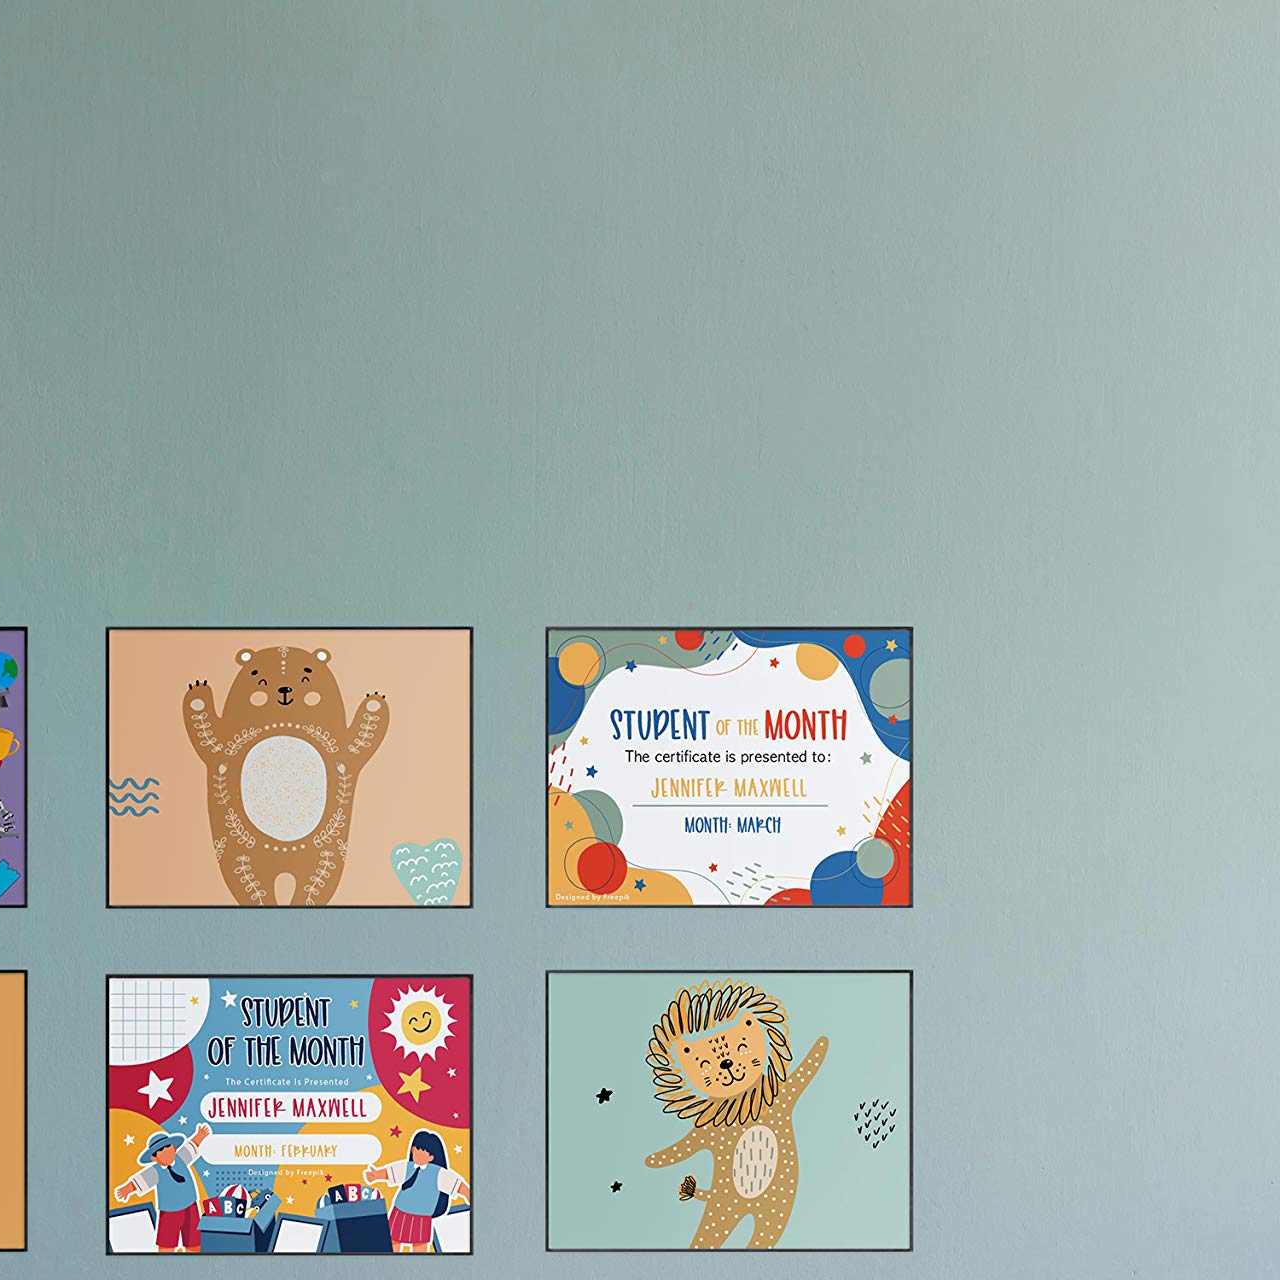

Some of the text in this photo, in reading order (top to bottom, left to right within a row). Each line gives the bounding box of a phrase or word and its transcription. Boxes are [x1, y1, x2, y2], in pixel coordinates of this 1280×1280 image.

[610, 708, 847, 741] STUDENT OF THE MONTH
[625, 750, 832, 765] The certificate is presented to:
[651, 777, 807, 798] JENNIFER MAXWELL
[685, 816, 781, 833] MONTH: MARCH
[555, 893, 630, 902] Designed by Freepik
[241, 996, 331, 1028] STUDENT
[208, 1035, 365, 1067] OF THE MONTH
[225, 1077, 349, 1086] The Certificate Is Presented
[208, 1097, 367, 1118] JENNIFER MAXWELL
[281, 1144, 337, 1158] FEBRUARY
[248, 1169, 324, 1177] Designed by Freepik
[335, 1186, 369, 1202] A B C
[208, 1201, 244, 1214] A B C
